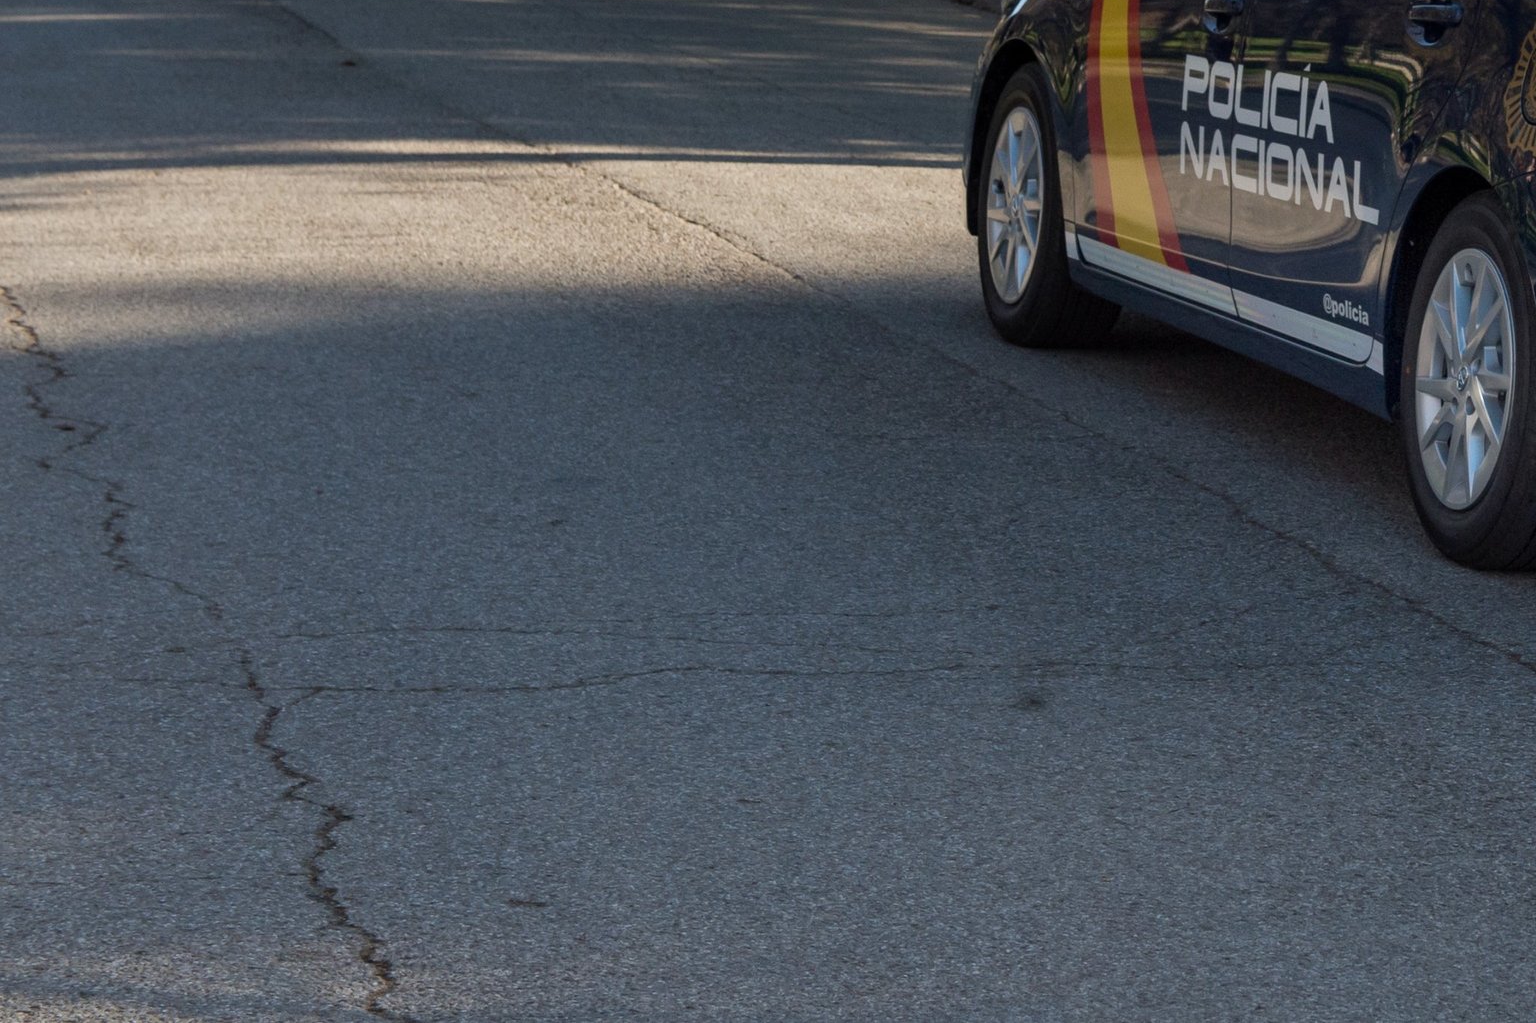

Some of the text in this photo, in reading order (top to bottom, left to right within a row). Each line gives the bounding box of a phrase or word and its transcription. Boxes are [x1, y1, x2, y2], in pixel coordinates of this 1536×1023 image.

[1182, 54, 1334, 144] POLICÍA
[1179, 121, 1380, 226] NACIONAL
[1323, 293, 1370, 326] @policia
